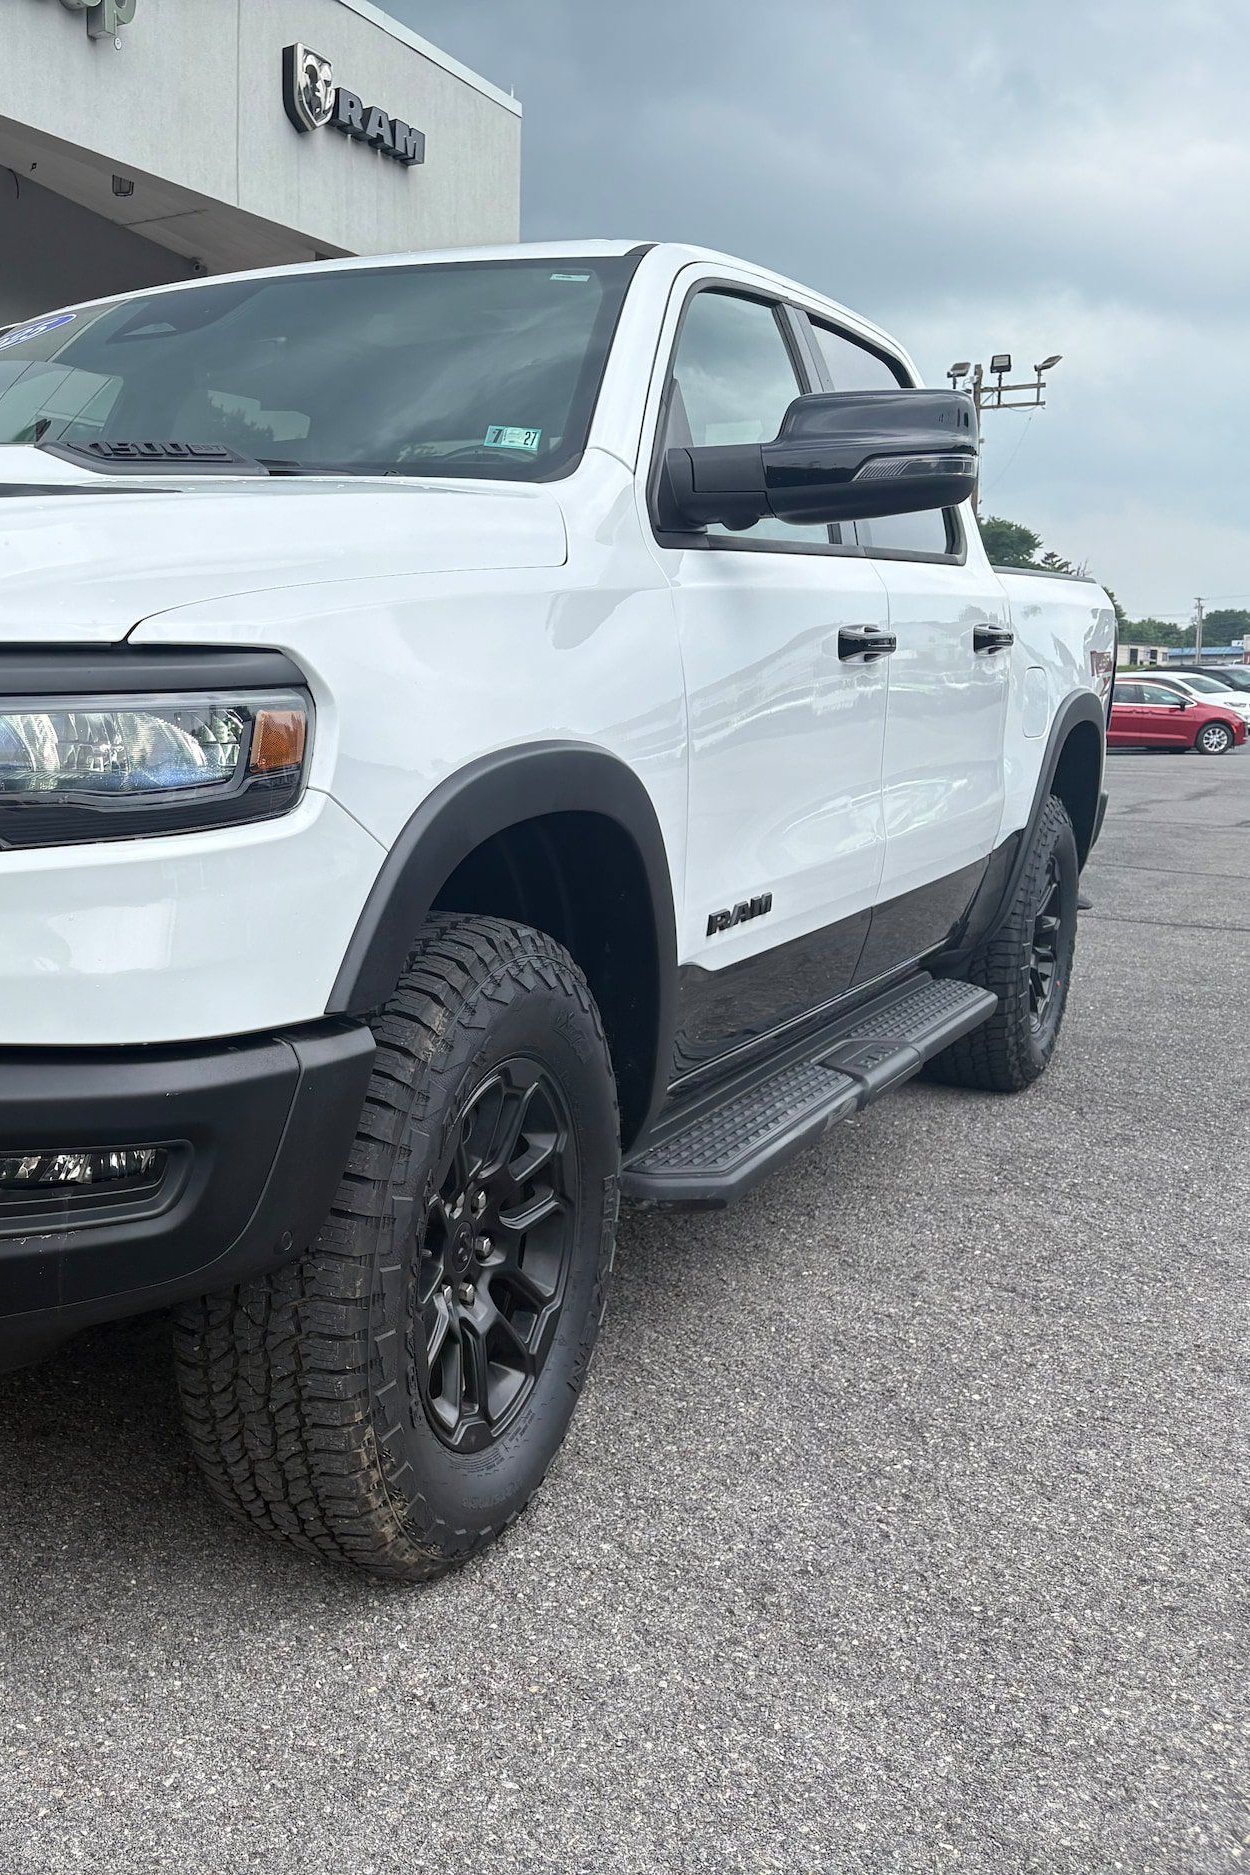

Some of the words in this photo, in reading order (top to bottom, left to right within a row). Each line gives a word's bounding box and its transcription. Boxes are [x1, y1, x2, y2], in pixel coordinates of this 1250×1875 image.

[332, 87, 425, 165] RAM
[492, 428, 504, 444] 7
[523, 431, 538, 446] 27
[706, 891, 773, 937] RAM
